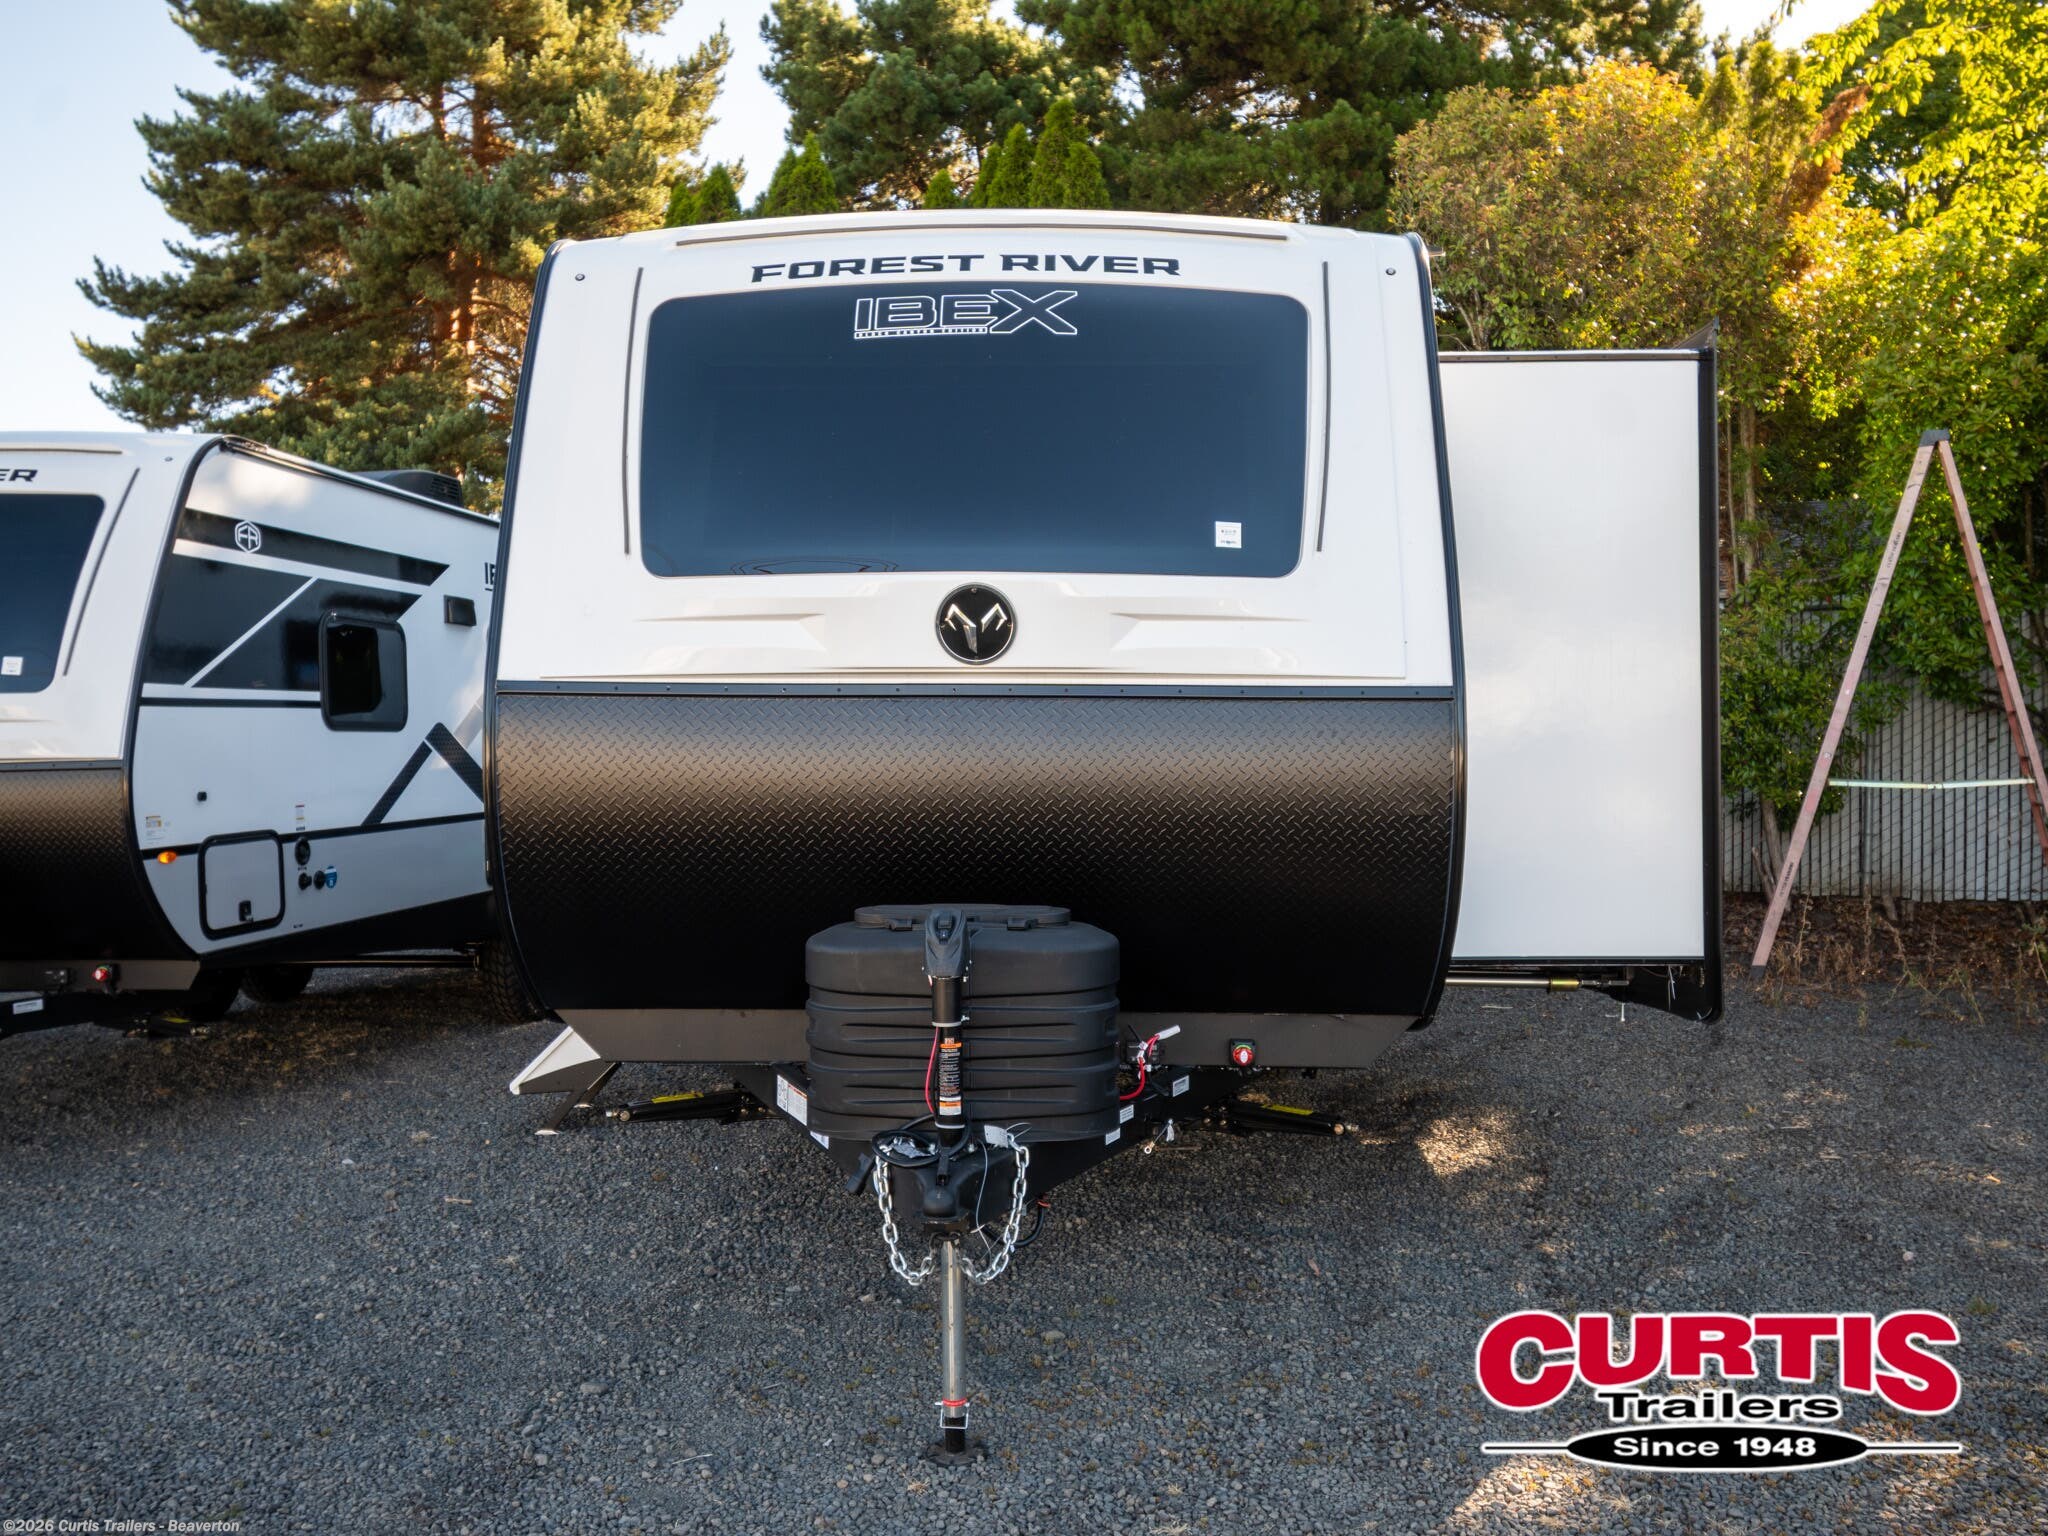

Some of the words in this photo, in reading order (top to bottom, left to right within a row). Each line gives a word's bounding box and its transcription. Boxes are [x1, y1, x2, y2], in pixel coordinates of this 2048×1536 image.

[751, 254, 985, 283] FOREST
[999, 254, 1182, 276] RIVER
[853, 288, 1079, 335] IBEX
